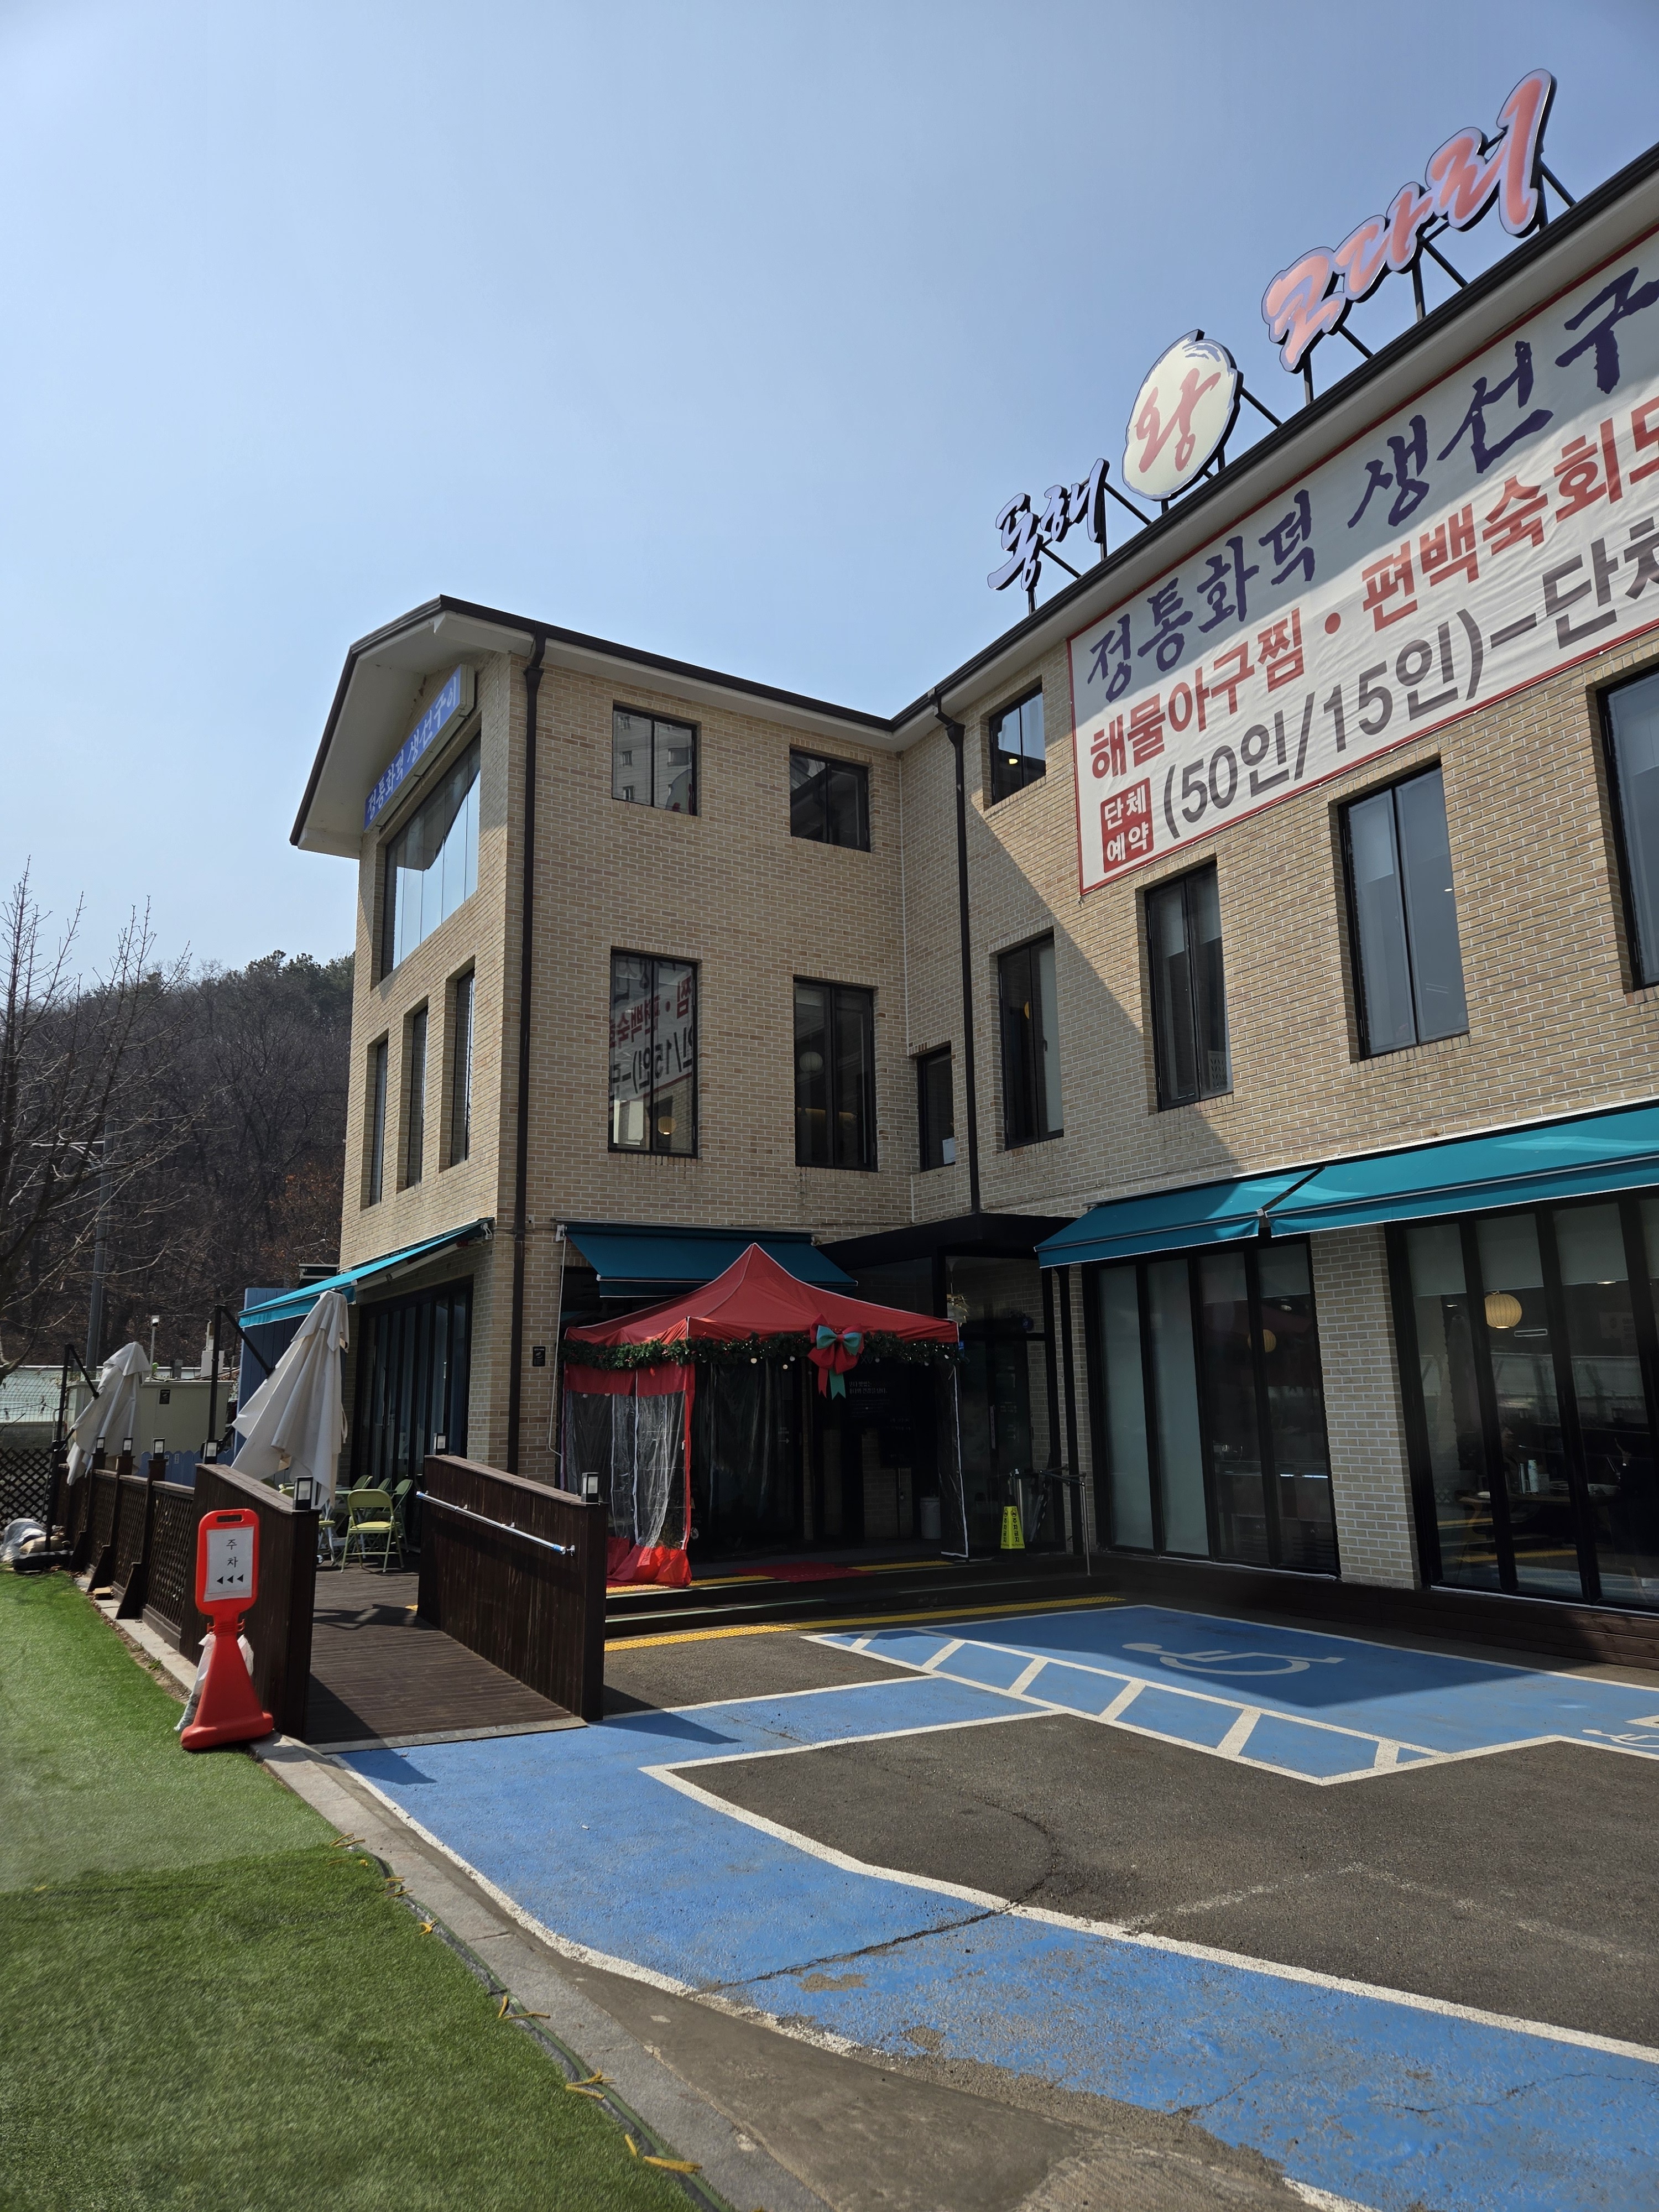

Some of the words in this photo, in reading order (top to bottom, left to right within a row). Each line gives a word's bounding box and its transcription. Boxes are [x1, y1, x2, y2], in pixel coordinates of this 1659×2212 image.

[1134, 367, 1222, 473] 왕
[1262, 68, 1555, 373] 코다리
[1087, 489, 1316, 703] 정통화덕
[367, 749, 404, 821] 정통화덕
[407, 676, 457, 764] 생선구이
[1090, 607, 1305, 779] 해물아구찜
[1104, 784, 1146, 830] 단체
[1107, 821, 1149, 862] 예약
